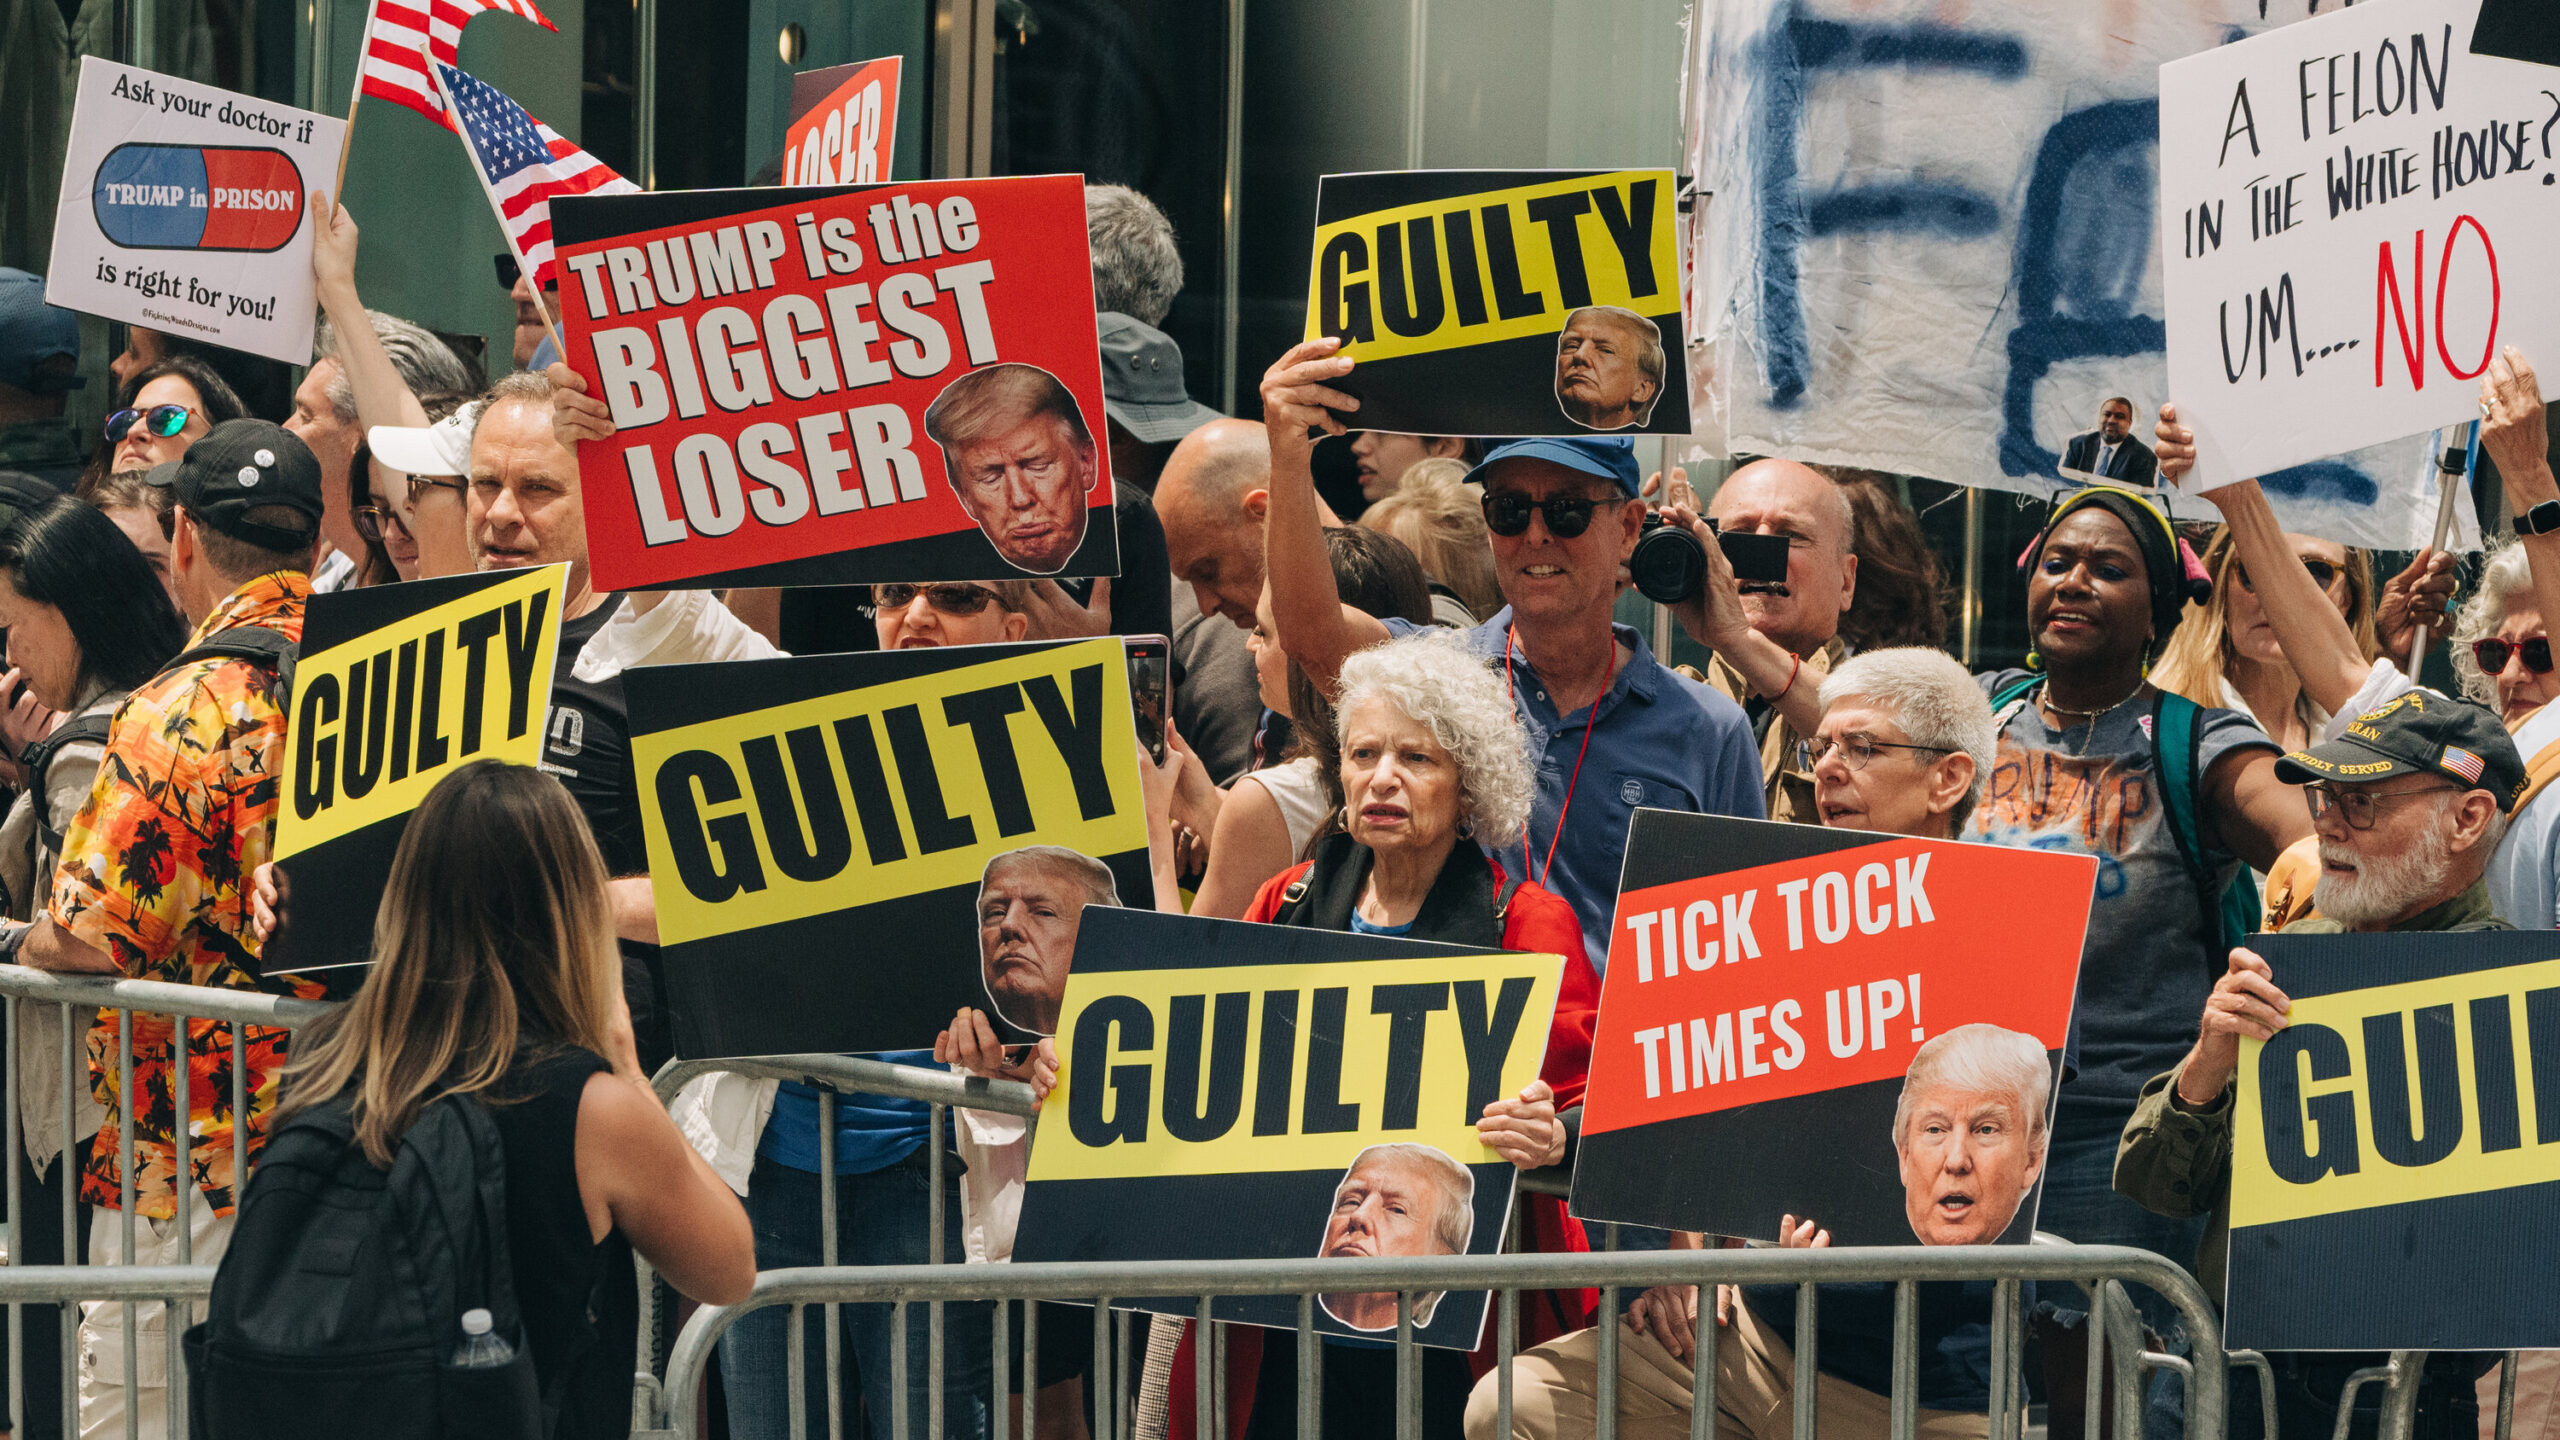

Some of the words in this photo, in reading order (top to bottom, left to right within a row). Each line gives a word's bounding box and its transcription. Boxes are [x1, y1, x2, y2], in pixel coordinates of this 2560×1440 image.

[111, 73, 155, 106] Ask
[161, 91, 212, 119] your
[218, 100, 291, 138] doctor
[296, 119, 314, 144] if
[2218, 77, 2261, 168] A
[2299, 23, 2452, 142] FELON
[104, 183, 184, 207] TRUMP
[189, 188, 208, 208] in
[213, 188, 295, 212] PRISON
[2185, 199, 2224, 259] IN
[2243, 172, 2308, 242] THE
[2325, 145, 2422, 221] WHITE
[2432, 90, 2560, 200] HOUSE?
[96, 256, 117, 284] is
[123, 266, 182, 298] right
[188, 277, 222, 308] for
[226, 296, 276, 321] you!
[567, 220, 787, 320] TRUMP
[796, 212, 865, 279] is
[868, 194, 981, 266] the
[1319, 178, 1658, 348] GUILTY
[2375, 214, 2500, 392] NO
[591, 259, 999, 432] BIGGEST
[624, 402, 928, 548] LOSER
[292, 587, 551, 821] GUILTY
[2339, 760, 2393, 775] SERVED
[654, 662, 1116, 904] GUILTY
[1986, 753, 2149, 852] RUMP
[1626, 888, 1762, 984] TICK
[1777, 851, 1936, 951] TOCK
[1067, 976, 1537, 1149] GUILTY
[1634, 998, 1806, 1100] TIMES
[1825, 972, 1925, 1060] UP!
